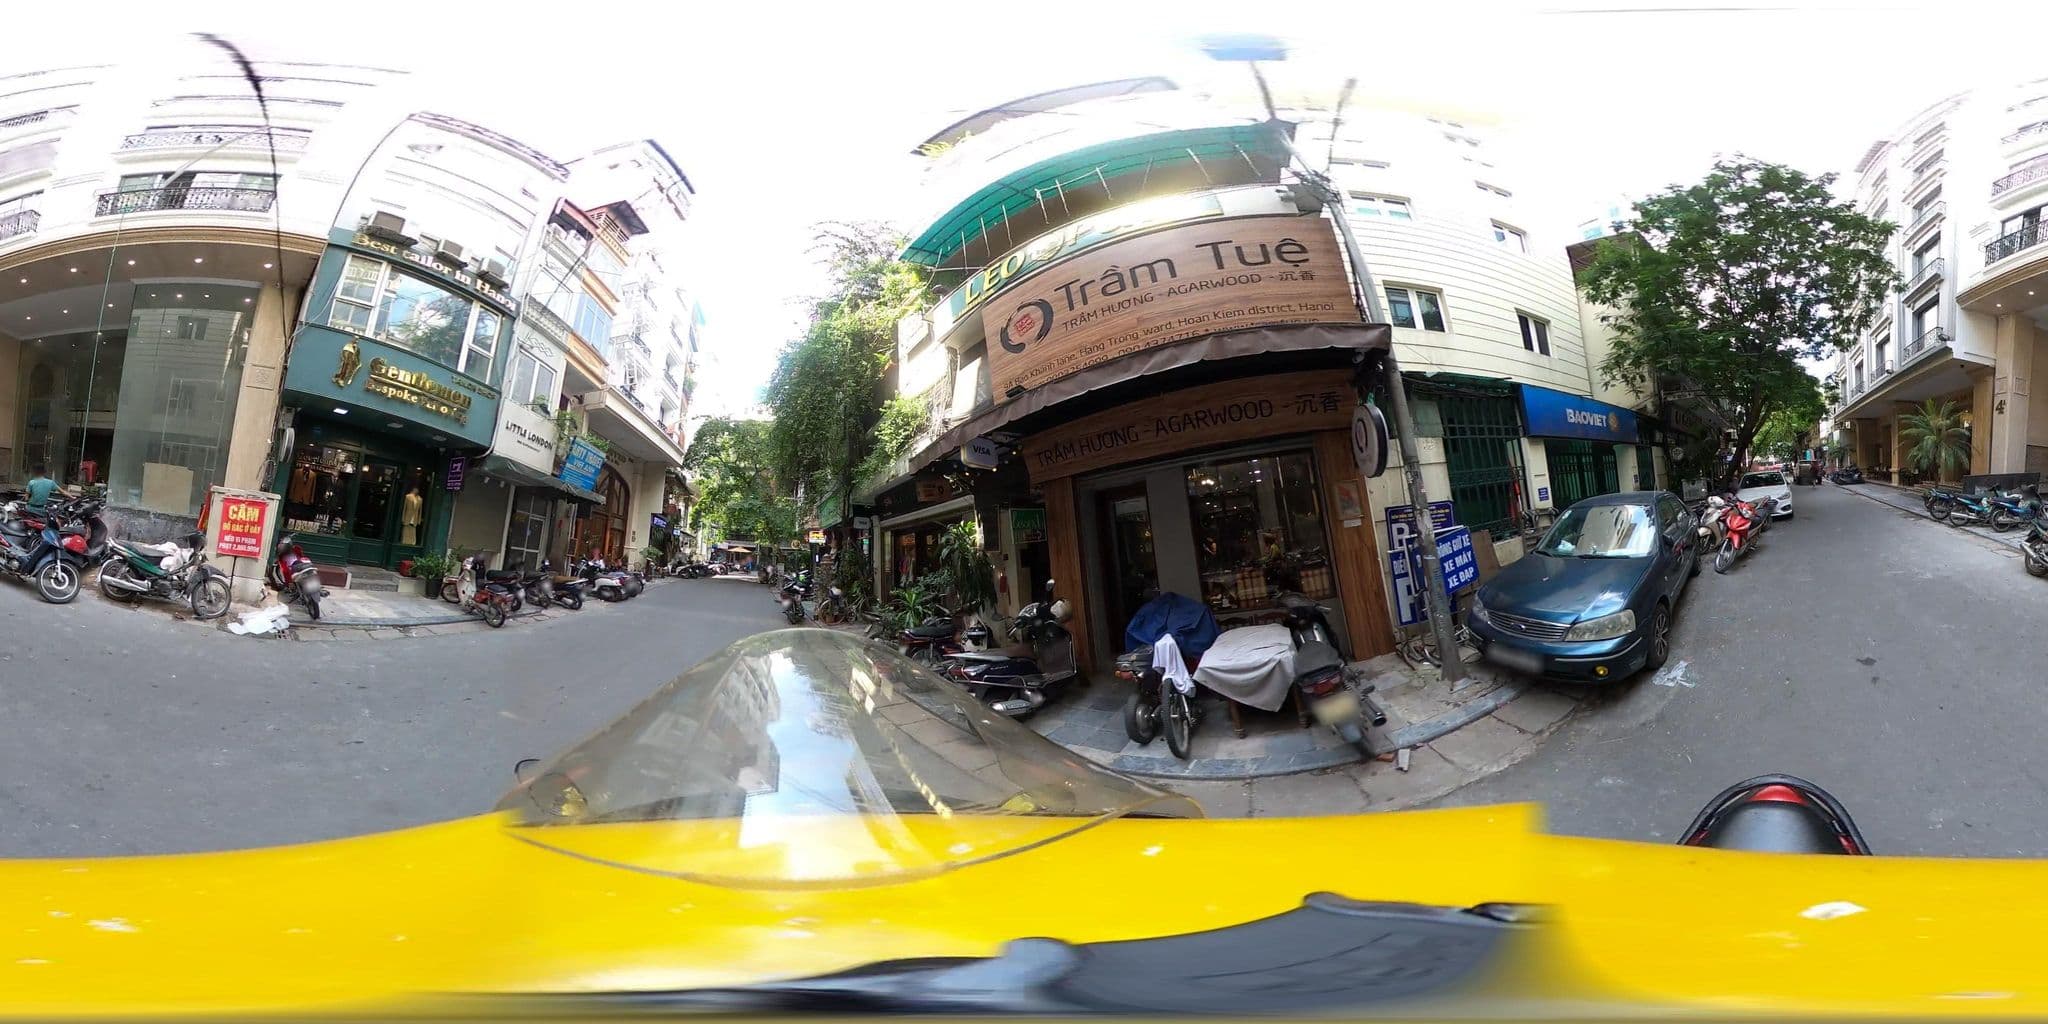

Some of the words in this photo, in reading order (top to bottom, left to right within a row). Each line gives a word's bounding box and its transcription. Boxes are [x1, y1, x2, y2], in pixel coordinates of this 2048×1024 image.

[352, 232, 398, 255] Best
[402, 249, 453, 275] tailor
[454, 270, 471, 286] in
[1054, 258, 1178, 312] Trầm
[1195, 237, 1310, 270] Tuệ
[1167, 273, 1262, 297] AGARWOOD
[1279, 270, 1316, 282] 沉香
[1108, 331, 1139, 346] Trong
[1178, 314, 1210, 327] Hoan
[1213, 309, 1245, 321] Kiem
[1248, 304, 1295, 316] district,
[1299, 302, 1335, 311] Hanoi
[1155, 399, 1273, 438] AGARWOOD
[1566, 408, 1607, 428] BAOVIET
[505, 419, 527, 438] LITTLE
[527, 430, 554, 451] LONDON
[973, 444, 991, 456] VISA
[1462, 534, 1471, 547] XE
[1443, 559, 1455, 573] XE
[1455, 550, 1472, 568] MÁY
[1448, 574, 1459, 589] XE
[1459, 566, 1474, 583] ĐẠP
